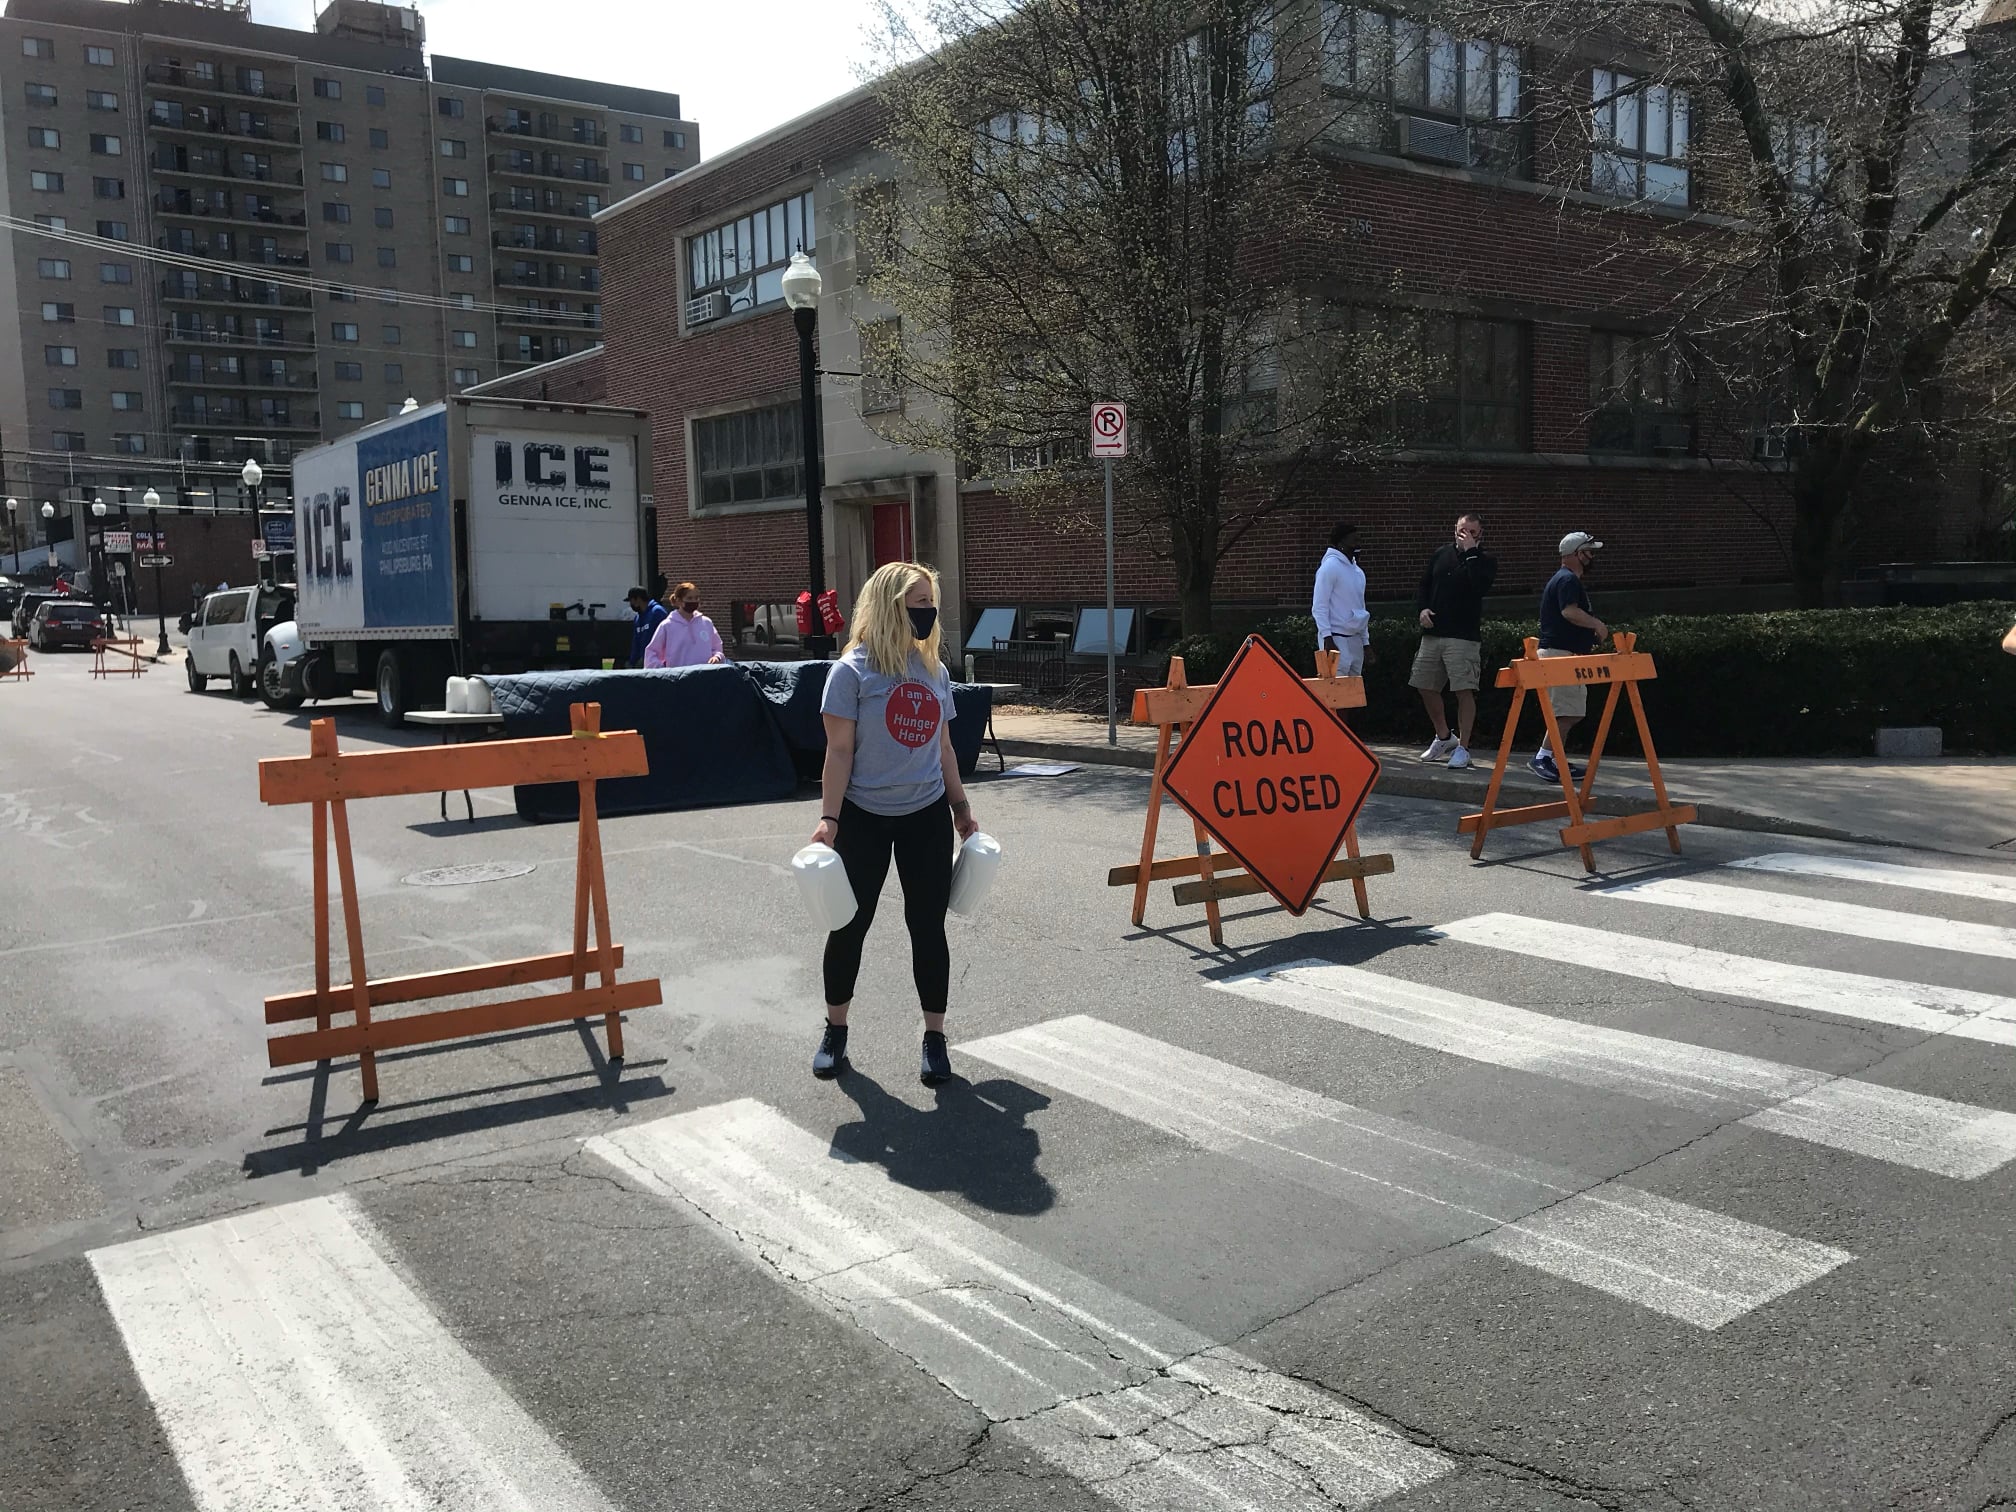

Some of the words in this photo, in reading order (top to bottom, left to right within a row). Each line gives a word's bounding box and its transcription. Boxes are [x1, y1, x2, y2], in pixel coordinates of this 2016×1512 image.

[365, 459, 411, 507] GENNA
[412, 451, 439, 495] ICE
[494, 441, 611, 494] ICE
[499, 494, 552, 508] GENNA
[555, 496, 581, 509] ICE,
[584, 498, 612, 510] INC.
[303, 486, 353, 590] ICE
[906, 690, 923, 700] am
[926, 693, 932, 701] a
[911, 700, 922, 715] Y
[893, 713, 935, 731] Hunger
[899, 729, 926, 743] Hero
[1222, 719, 1314, 758] ROAD
[1213, 774, 1341, 819] CLOSED
